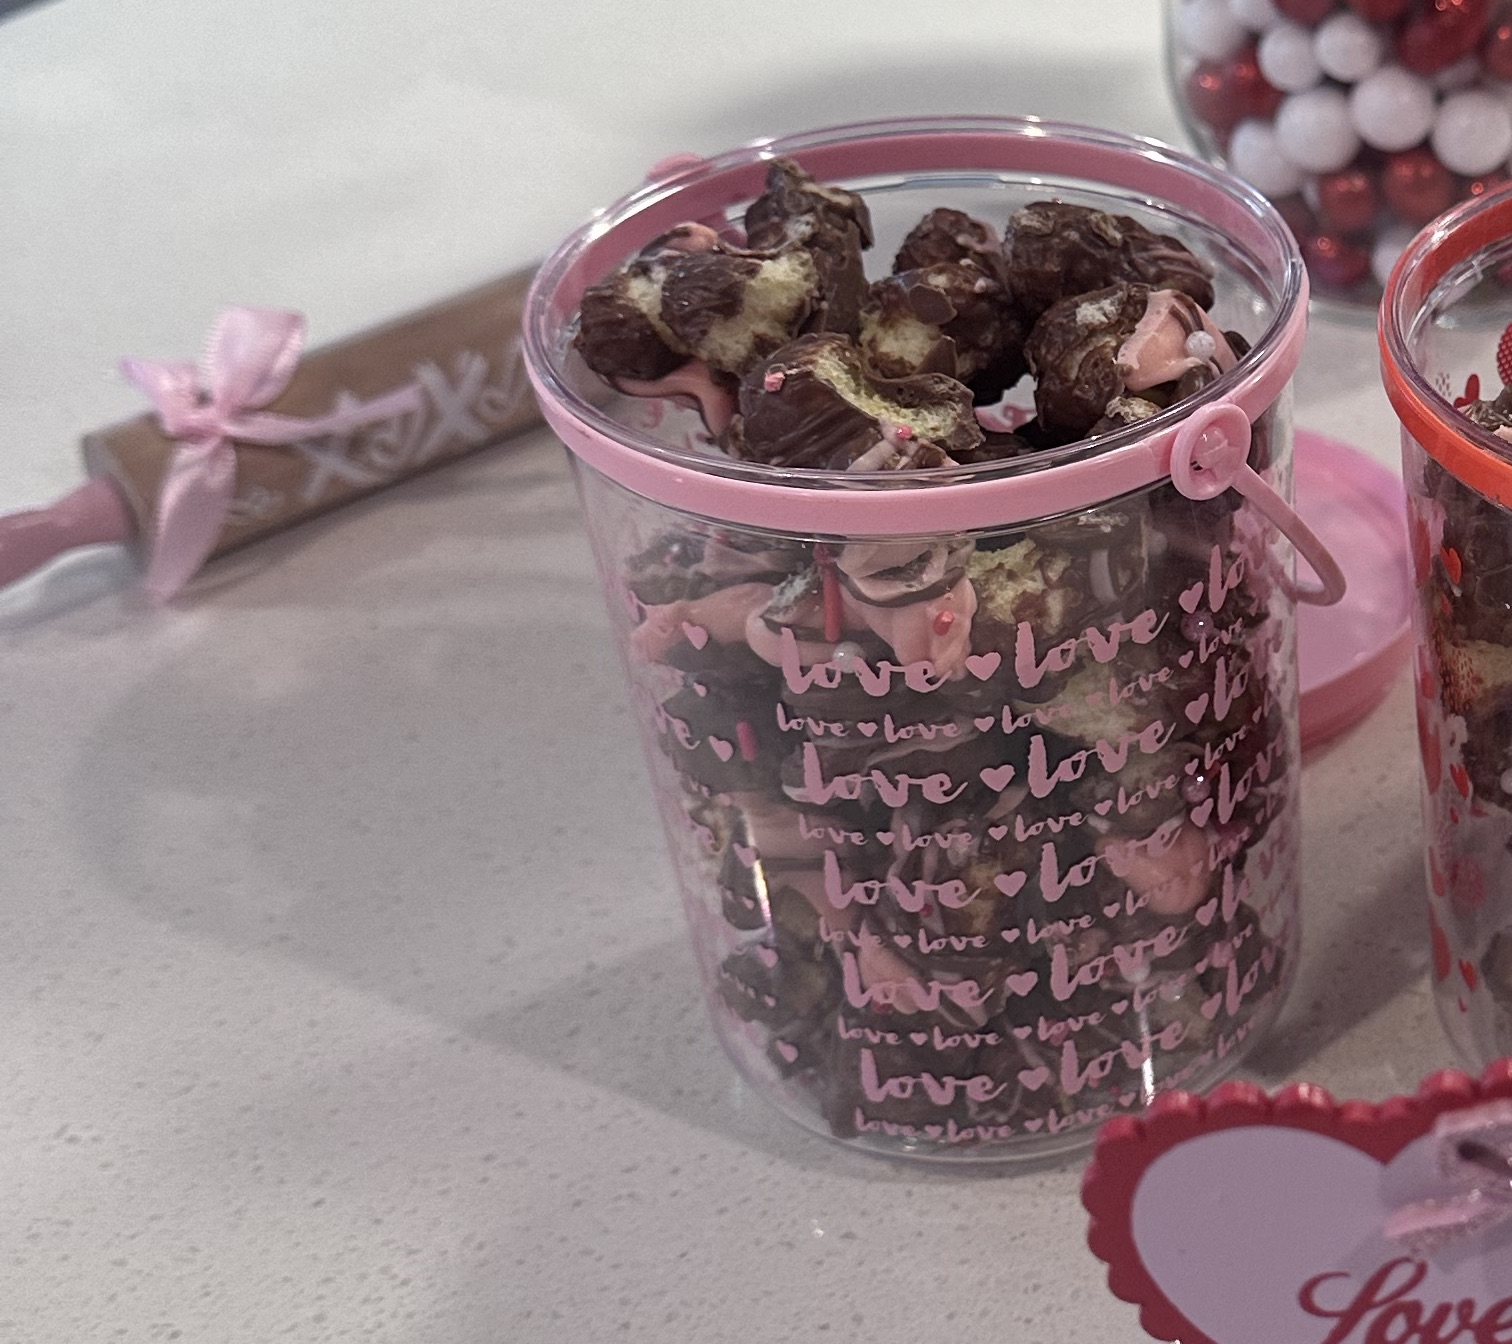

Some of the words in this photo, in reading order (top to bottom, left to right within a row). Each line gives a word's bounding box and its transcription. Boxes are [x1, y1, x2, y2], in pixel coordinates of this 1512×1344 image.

[781, 627, 952, 696] love
[1015, 609, 1169, 688] love
[777, 703, 850, 737] love
[884, 714, 963, 743] love
[1002, 705, 1070, 734] love
[1110, 666, 1174, 705] love
[803, 741, 968, 807] love
[1028, 720, 1176, 798] love
[800, 813, 868, 845] love
[903, 824, 972, 851] love
[1015, 814, 1088, 842] love
[1118, 774, 1180, 814] love
[824, 849, 982, 912] love
[1040, 821, 1183, 902] love
[820, 917, 885, 947] love
[919, 928, 990, 953] love
[1027, 913, 1097, 944] love
[843, 952, 994, 1011] love
[1051, 925, 1190, 1001] love
[838, 1015, 902, 1044] love
[934, 1026, 1002, 1050] love
[1038, 1012, 1106, 1041] love
[861, 1048, 1007, 1105] love
[1061, 1021, 1190, 1094] love
[855, 1107, 916, 1137] love
[948, 1119, 1014, 1143] love
[1048, 1106, 1113, 1135] love
